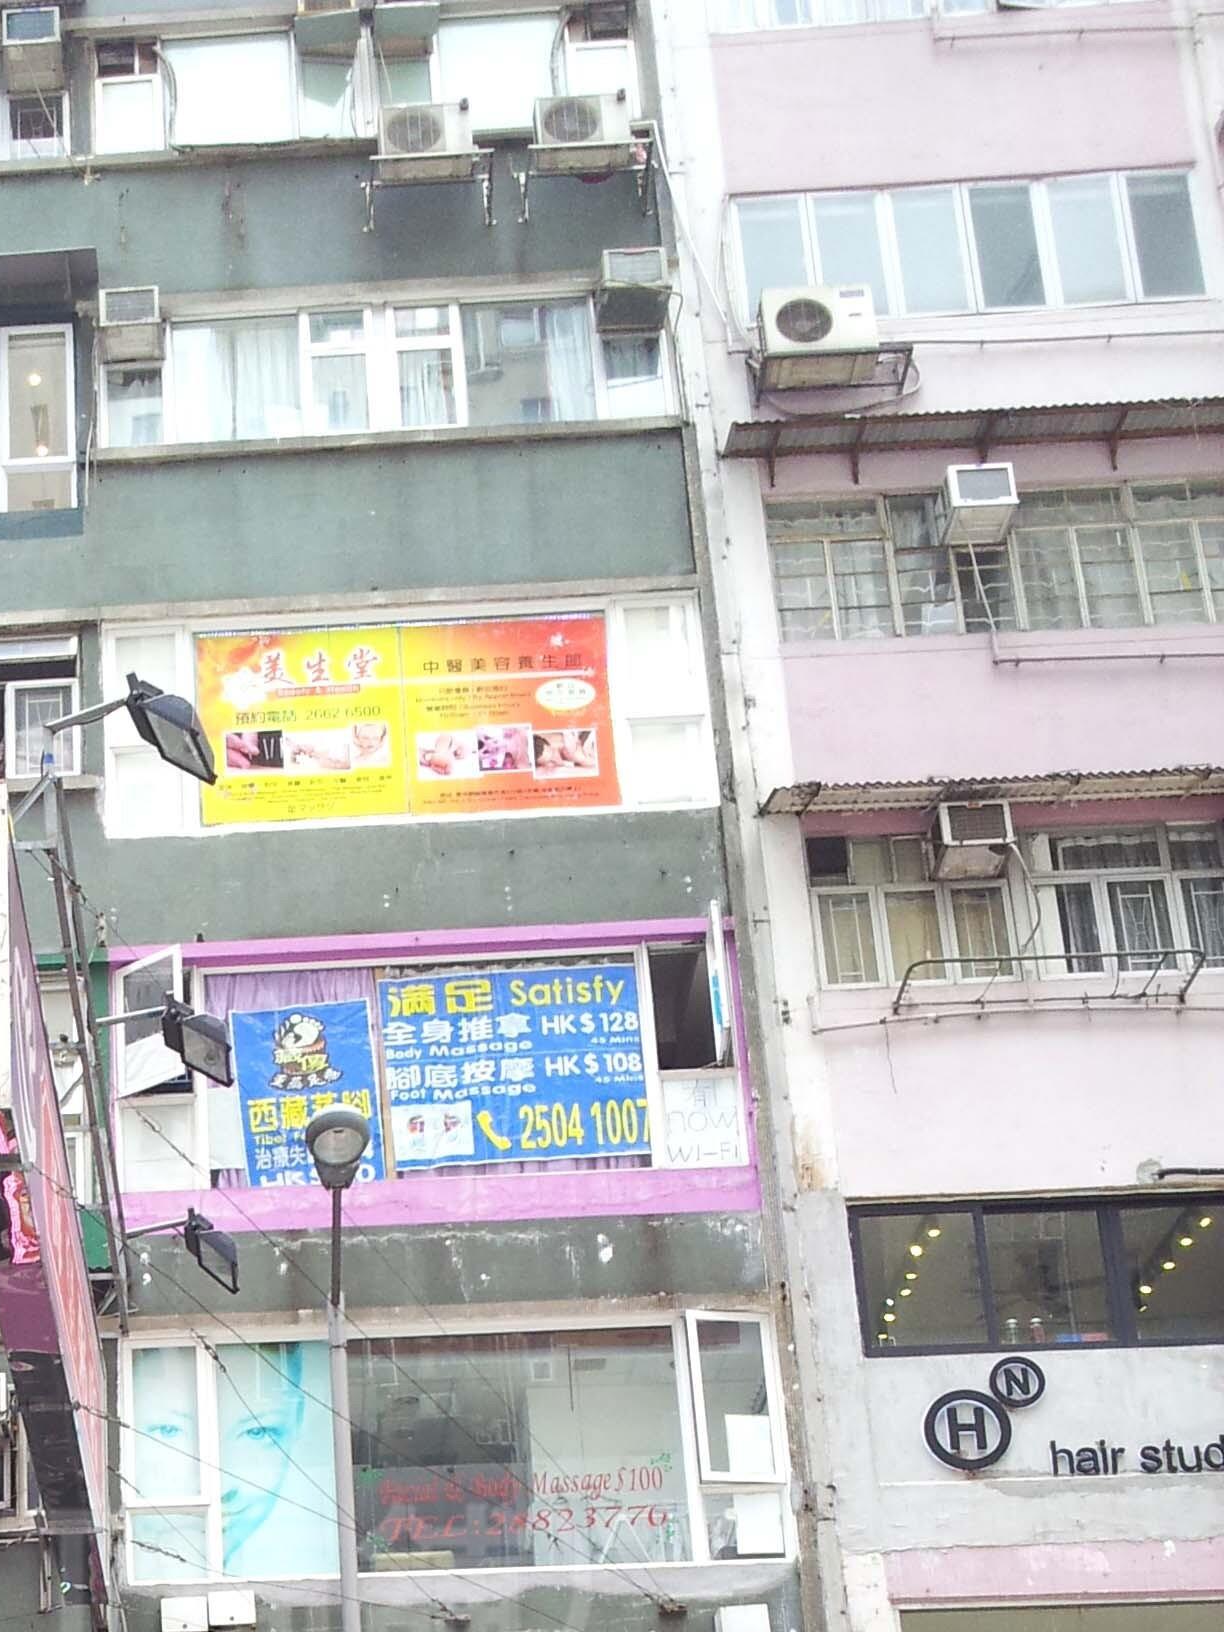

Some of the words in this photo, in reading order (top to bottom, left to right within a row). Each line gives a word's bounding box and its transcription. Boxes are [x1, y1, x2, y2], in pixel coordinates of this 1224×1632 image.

[263, 648, 377, 684] 美生堂
[306, 705, 339, 721] 2662
[345, 704, 381, 719] 6500
[509, 975, 624, 1006] Satisfy
[383, 1012, 532, 1046] 全身推拿
[541, 1014, 577, 1036] HK
[580, 1011, 595, 1035] $
[599, 1011, 639, 1033] 128
[386, 1047, 422, 1060] Body
[429, 1040, 533, 1057] Massage
[386, 1057, 536, 1090] 腳底按摩
[544, 1056, 581, 1077] HK
[584, 1052, 599, 1077] $
[605, 1052, 642, 1074] 108
[391, 1088, 427, 1101] Foot
[433, 1082, 537, 1101] Massage
[519, 1102, 585, 1149] 2504
[590, 1098, 651, 1145] 1007
[1050, 1439, 1125, 1477] hair
[532, 1471, 612, 1501] Massage
